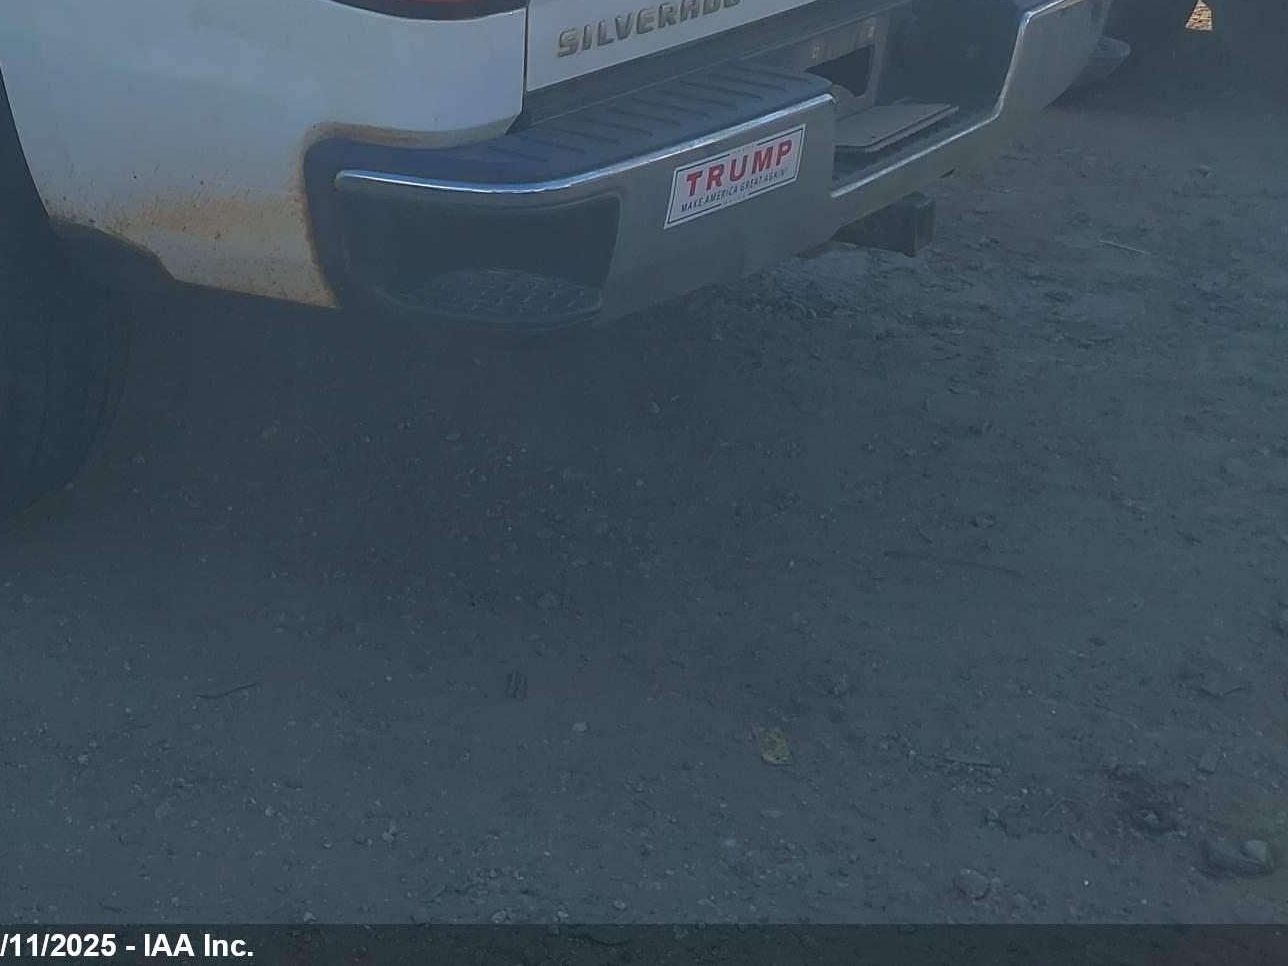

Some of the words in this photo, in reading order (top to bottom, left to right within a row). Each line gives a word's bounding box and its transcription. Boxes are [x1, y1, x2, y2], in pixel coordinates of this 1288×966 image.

[686, 140, 793, 197] TRUMP
[681, 198, 704, 212] MAKE
[704, 186, 738, 205] AMERICA
[739, 177, 763, 192] GREAT
